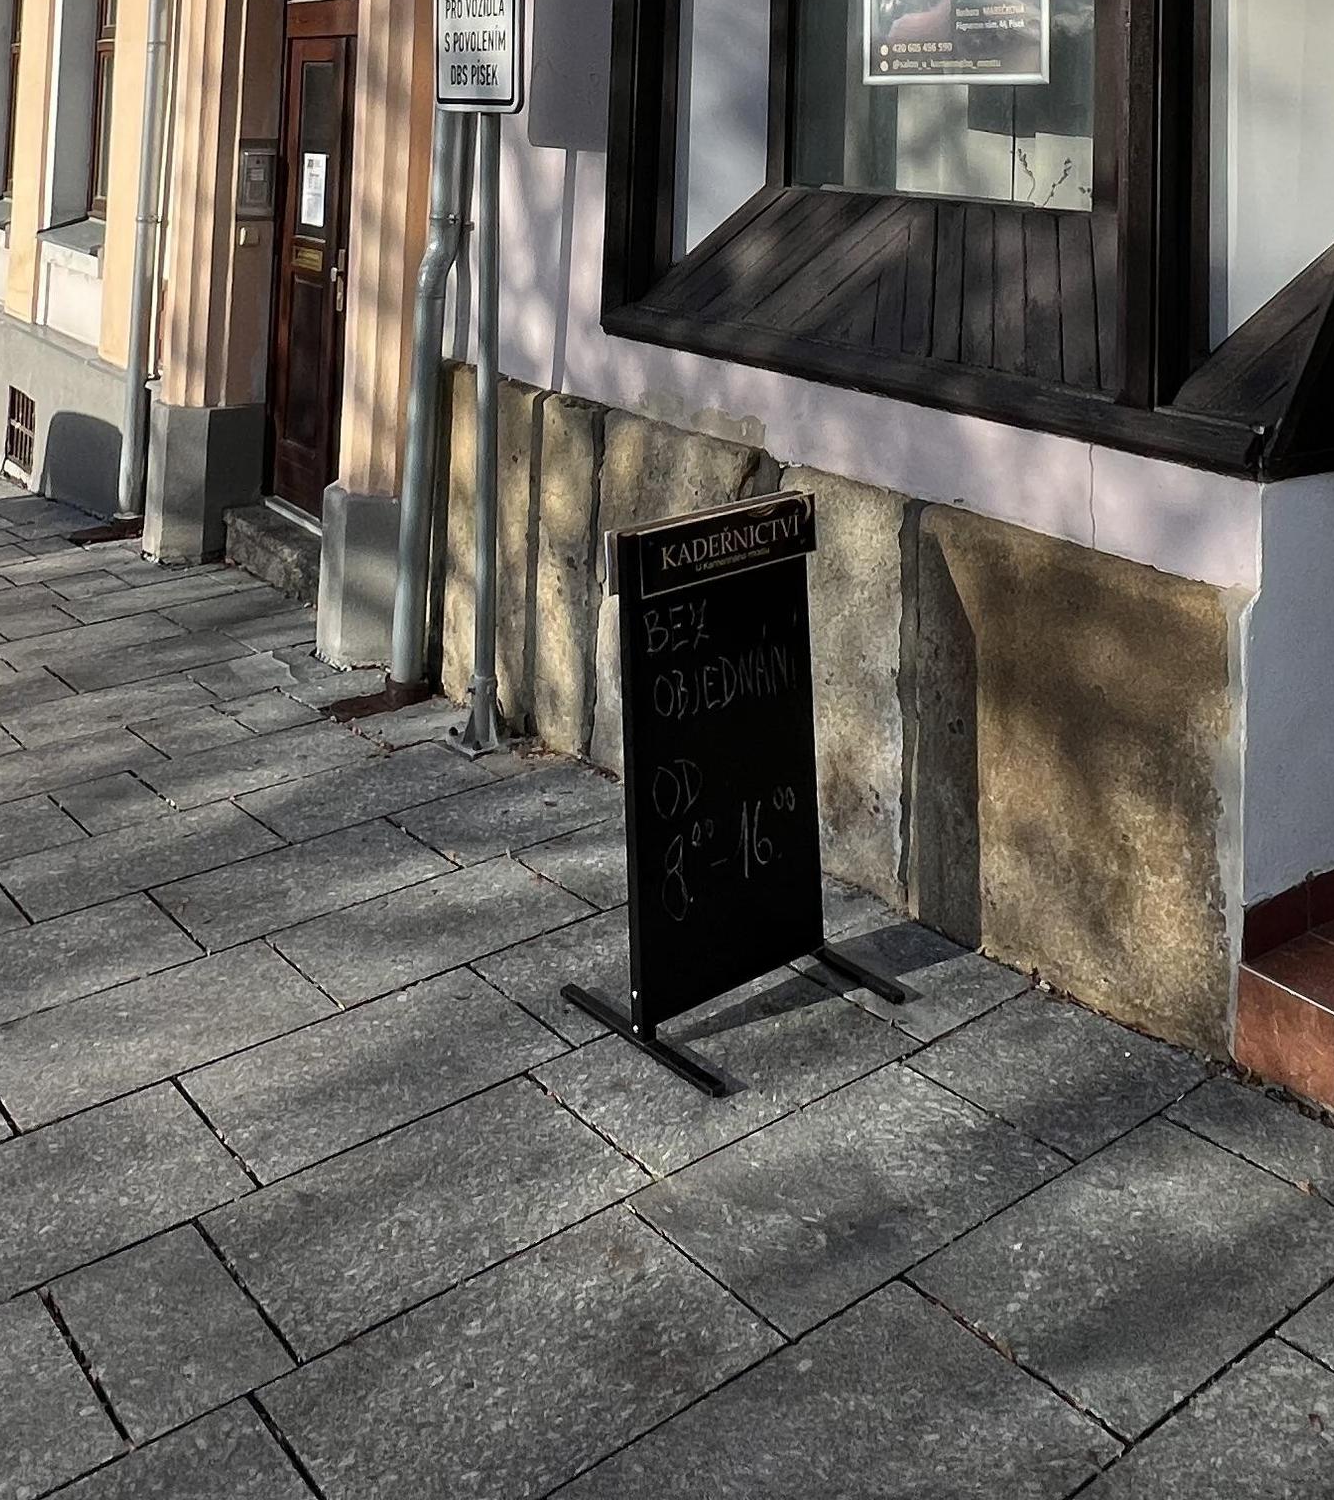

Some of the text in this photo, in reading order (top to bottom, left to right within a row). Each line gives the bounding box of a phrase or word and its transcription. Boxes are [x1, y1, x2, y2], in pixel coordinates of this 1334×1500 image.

[444, 24, 507, 53] S POVOLENÍM
[470, 58, 499, 87] PÍSEK
[661, 508, 800, 571] KADEŘNICTVÍ
